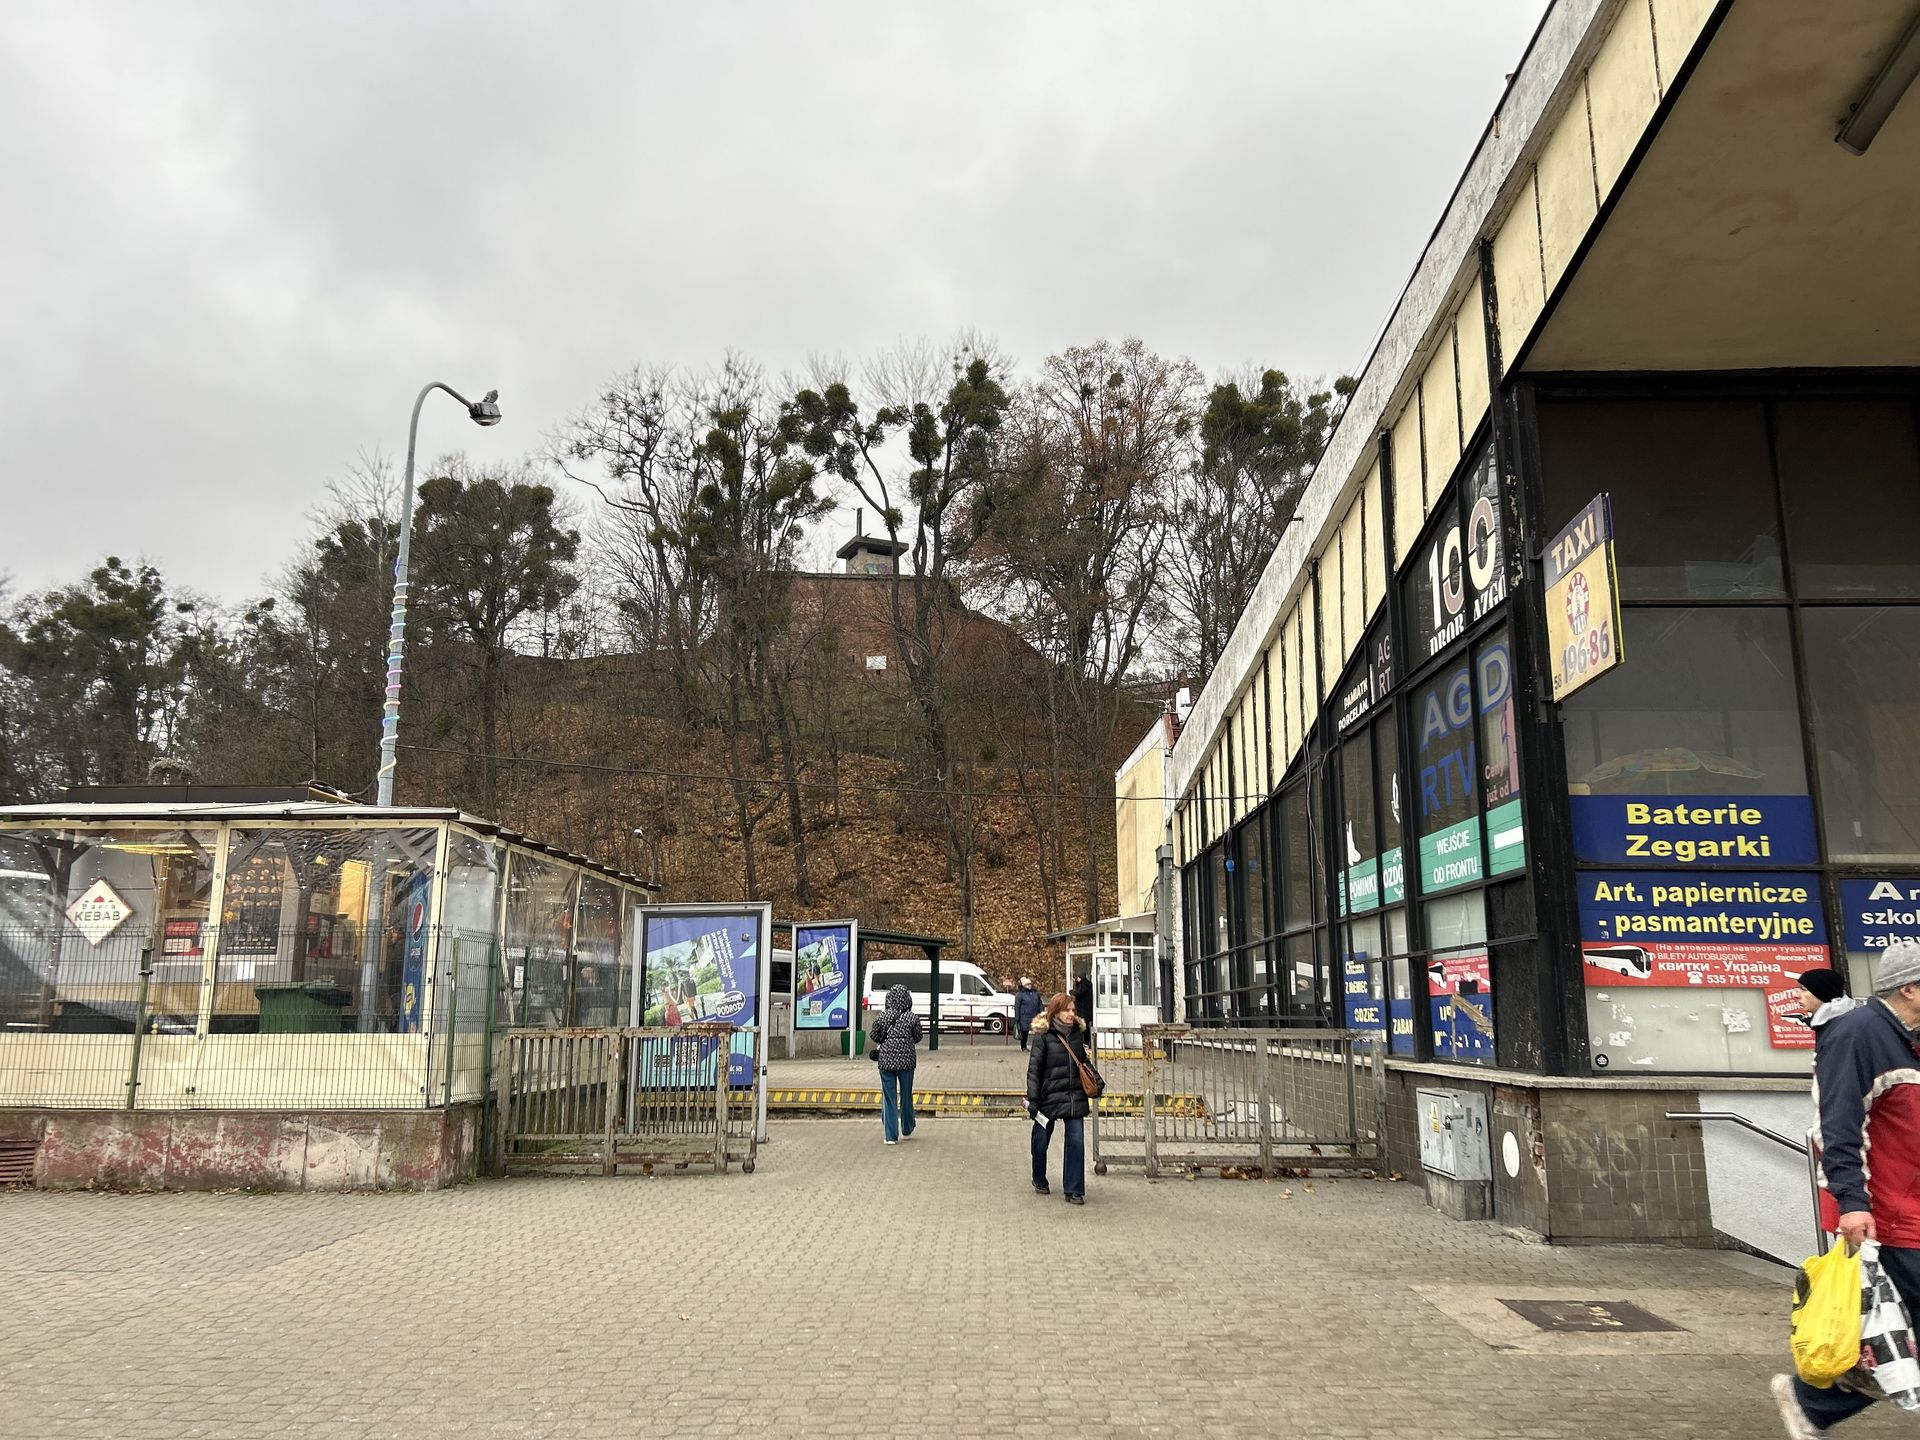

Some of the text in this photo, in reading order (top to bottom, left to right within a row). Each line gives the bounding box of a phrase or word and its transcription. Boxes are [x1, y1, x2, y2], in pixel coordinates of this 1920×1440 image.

[1551, 512, 1596, 575] TAXI
[1428, 496, 1496, 630] 100
[1420, 643, 1512, 752] AGD
[1421, 741, 1476, 817] RTV
[1500, 780, 1510, 798] od
[1626, 803, 1762, 825] Baterie
[1436, 829, 1470, 856] WEJŚCIE
[1626, 835, 1771, 862] Zegarki
[1433, 856, 1478, 884] OD FRONTU
[1595, 881, 1808, 907] Art. papiernicze
[74, 911, 121, 921] KEBAB
[1615, 911, 1814, 940] pasmanteryjne
[1656, 944, 1672, 952] (На
[1657, 952, 1748, 961] BILETY AUTOBUSOWE
[1807, 954, 1825, 962] PKS
[1658, 962, 1710, 971] квитки
[1722, 960, 1781, 974] Україна
[1706, 974, 1770, 985] 535 713 535
